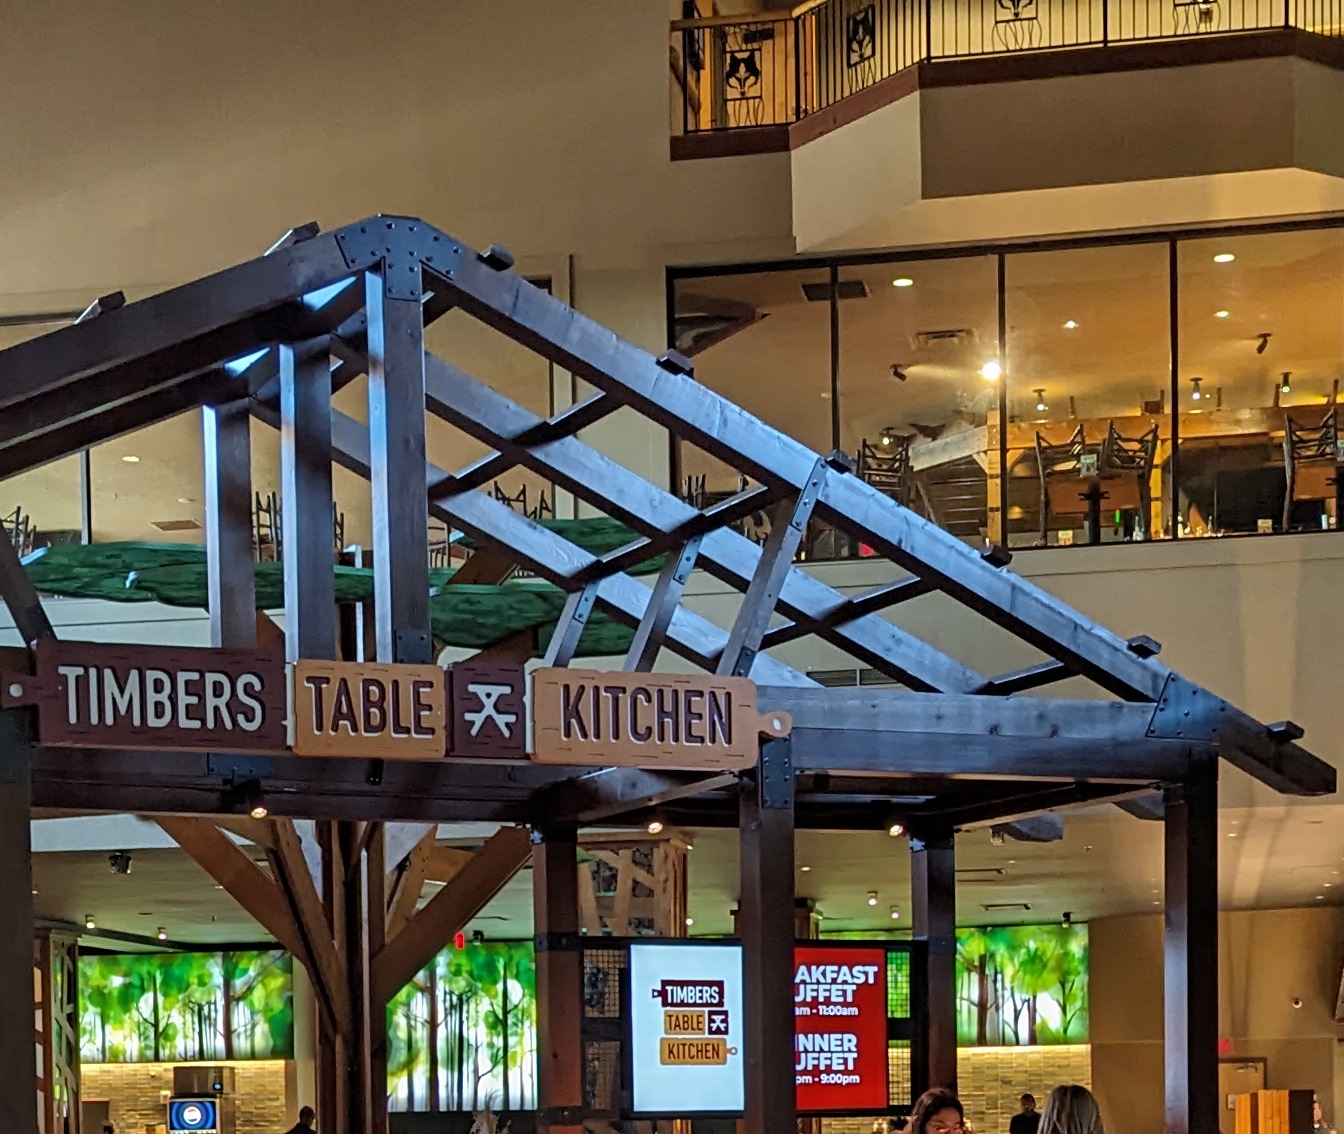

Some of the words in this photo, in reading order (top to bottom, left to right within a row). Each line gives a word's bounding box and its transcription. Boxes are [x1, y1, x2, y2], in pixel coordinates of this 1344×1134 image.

[56, 665, 266, 732] TIMBERS
[304, 674, 436, 740] TABLE
[560, 683, 735, 748] KITCHEN
[794, 965, 878, 984] AKFAST
[665, 985, 720, 1004] TIMBERS
[794, 984, 857, 1003] UFFET
[818, 1005, 859, 1016] 11:00am
[667, 1014, 704, 1032] TABLE
[667, 1042, 721, 1060] KITCHEN
[795, 1033, 857, 1052] NNER
[795, 1052, 858, 1071] UFFET
[820, 1073, 861, 1086] 9:00pm
